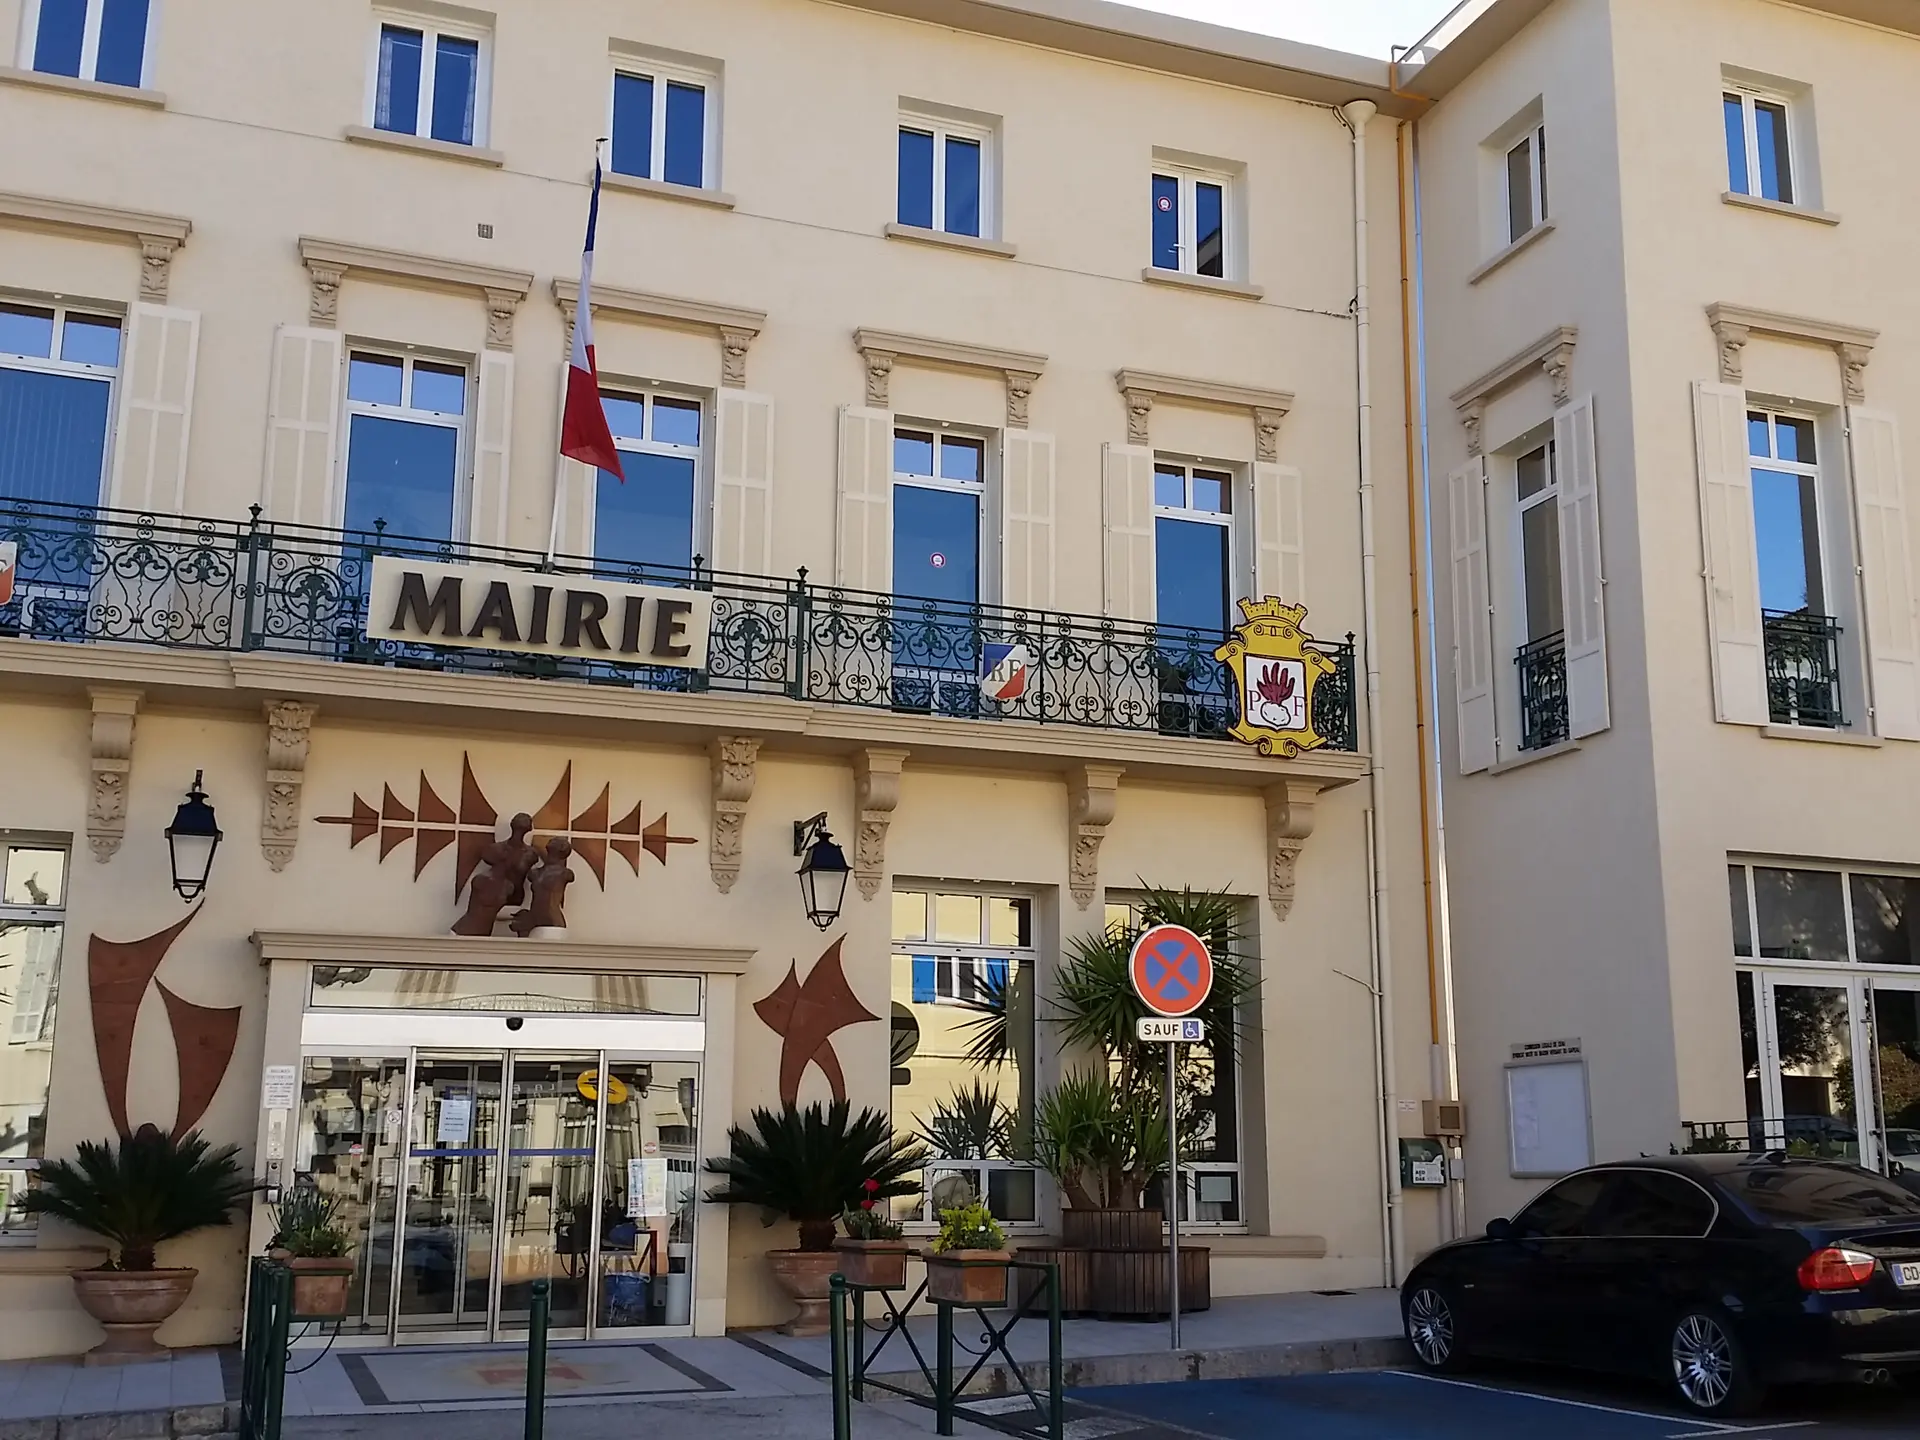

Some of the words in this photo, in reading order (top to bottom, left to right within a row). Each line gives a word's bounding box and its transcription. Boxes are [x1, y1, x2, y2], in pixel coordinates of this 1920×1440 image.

[389, 571, 693, 657] MAIRIE
[990, 659, 1021, 682] RF
[1248, 690, 1261, 711] P
[1293, 695, 1305, 716] F
[1144, 1023, 1179, 1036] SAUF
[1903, 1266, 1920, 1281] CD
